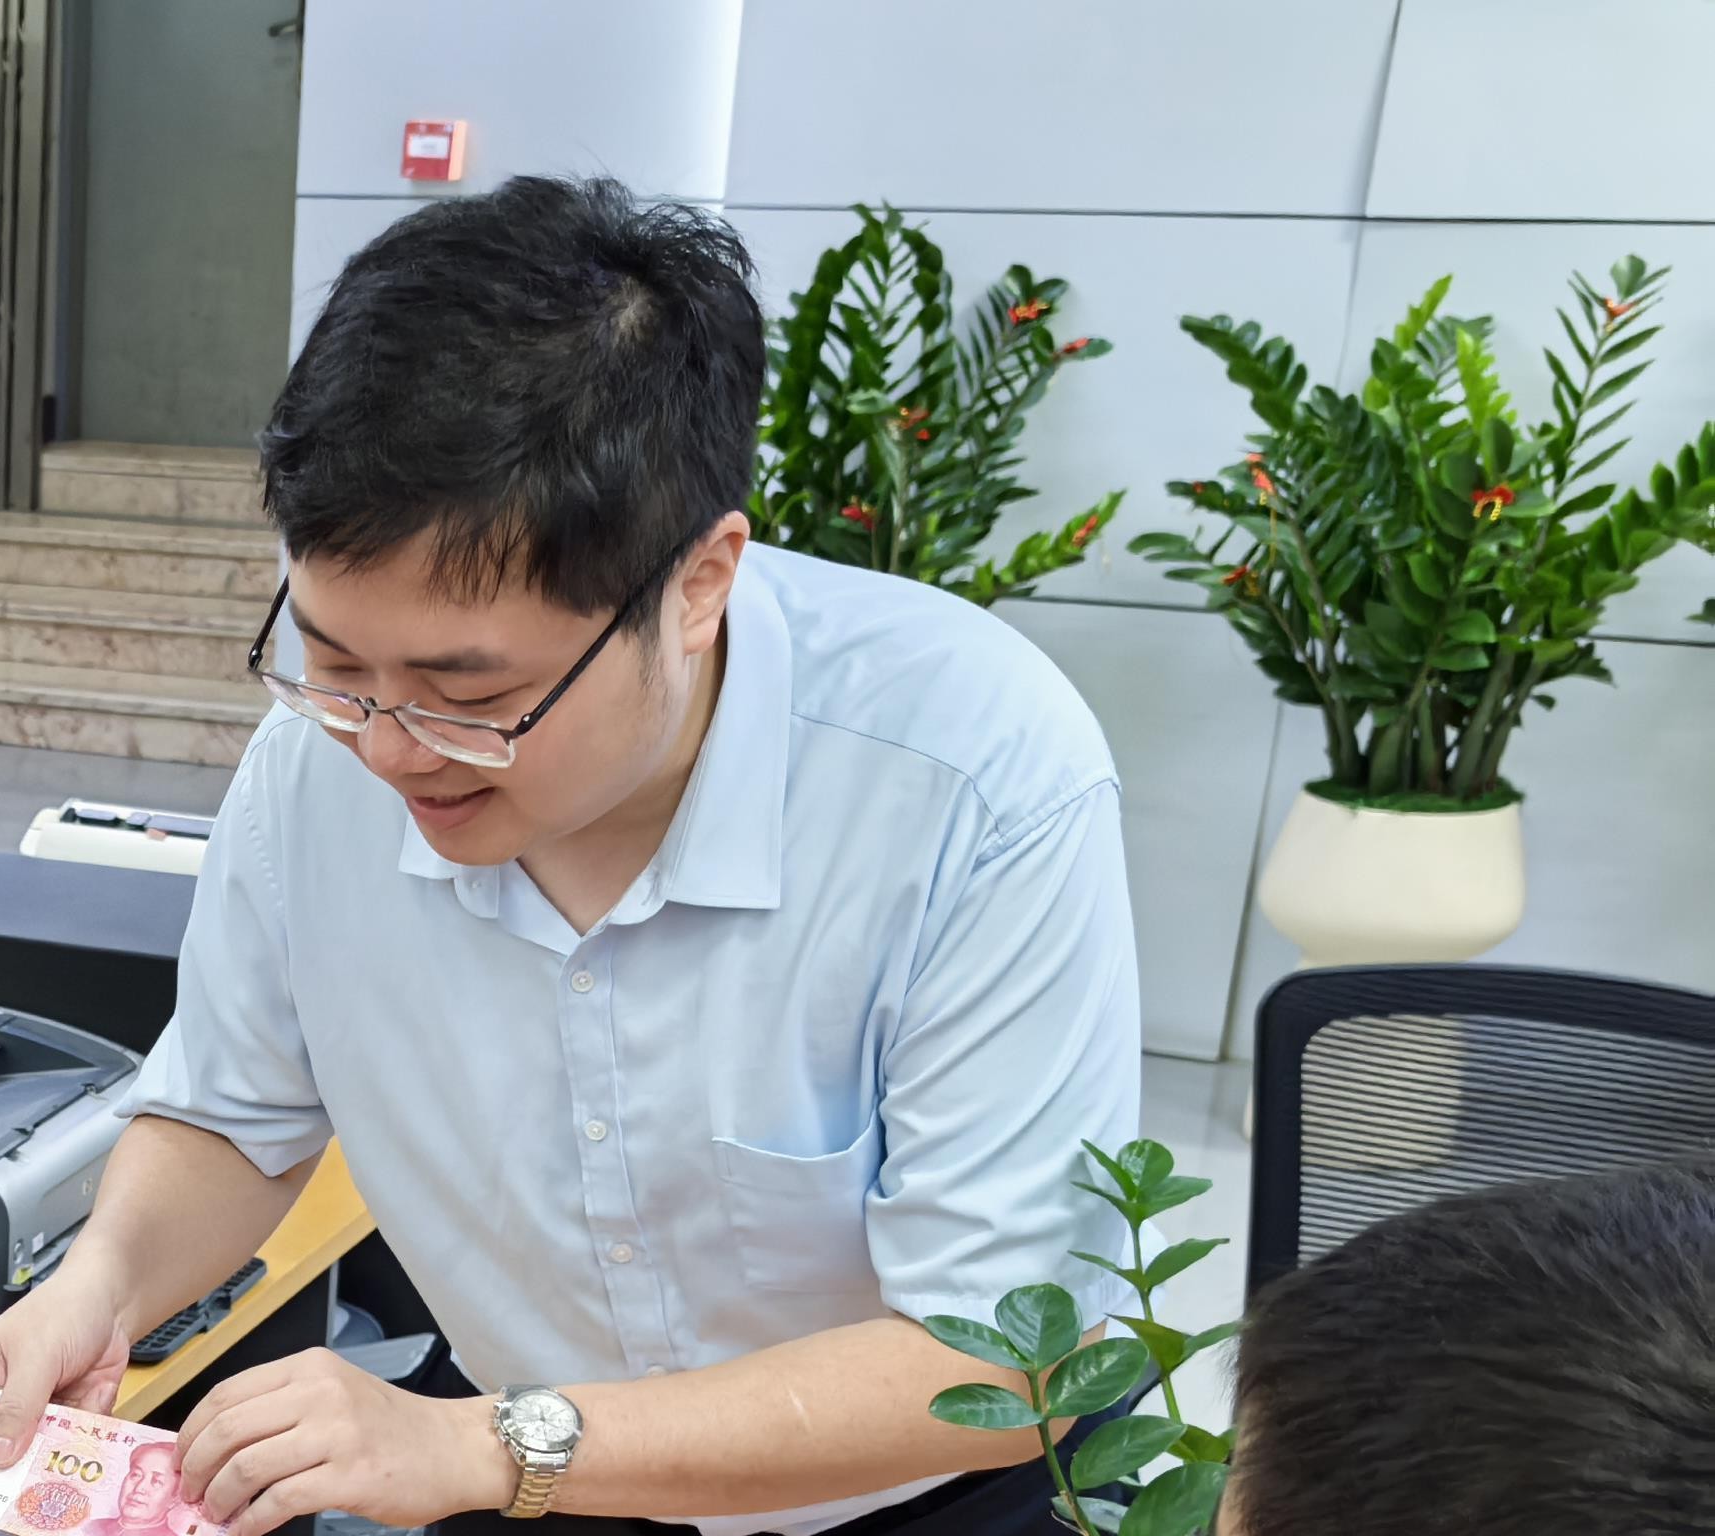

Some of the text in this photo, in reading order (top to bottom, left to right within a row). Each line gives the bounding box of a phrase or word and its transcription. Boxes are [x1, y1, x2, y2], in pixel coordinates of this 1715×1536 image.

[46, 1415, 137, 1447] 中国人民银行
[45, 1450, 103, 1483] 100
